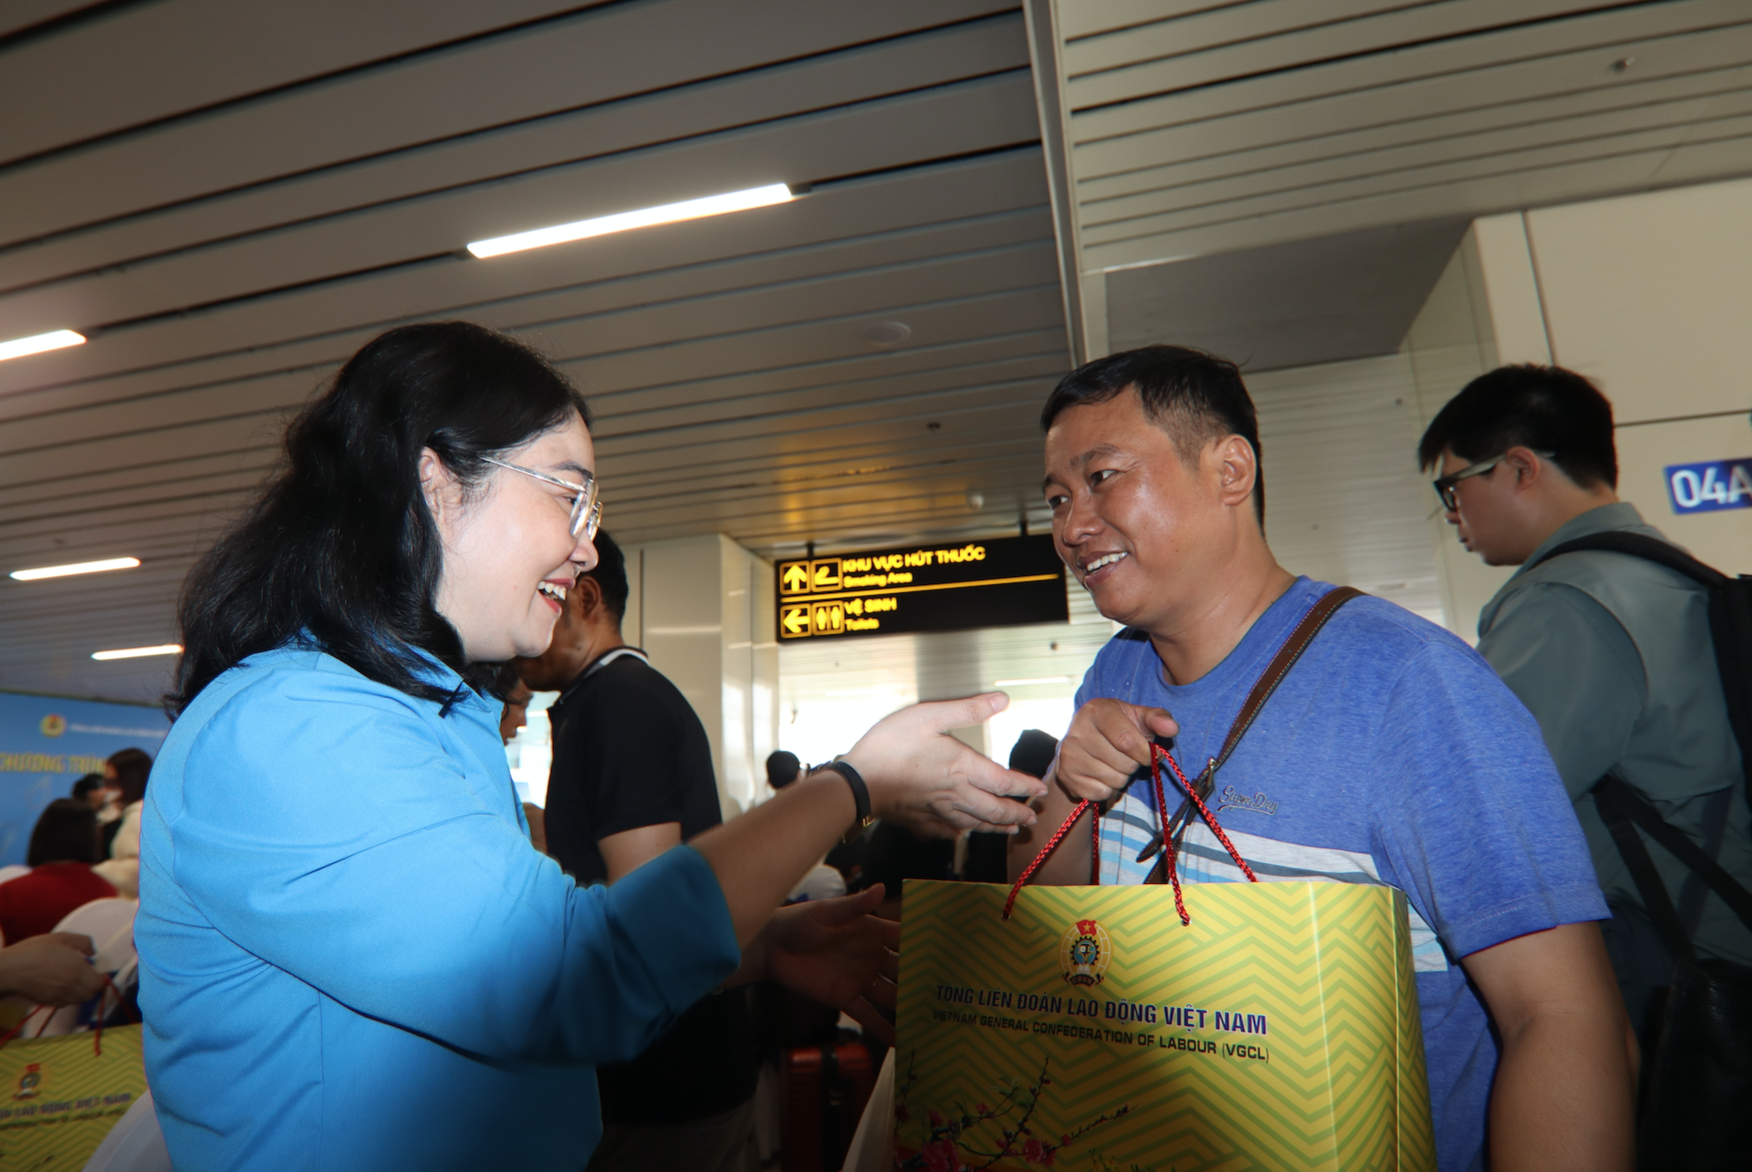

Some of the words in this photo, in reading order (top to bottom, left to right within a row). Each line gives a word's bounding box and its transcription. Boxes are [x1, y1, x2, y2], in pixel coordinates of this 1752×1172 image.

[1671, 464, 1752, 508] 04A
[843, 557, 872, 572] KHU
[873, 554, 903, 571] VỰC
[905, 550, 933, 567] HÚT
[935, 544, 985, 563] THUỐC
[887, 571, 913, 584] Area
[844, 598, 863, 616] VỆ
[864, 597, 897, 613] SINH
[978, 987, 1013, 1008] LIÊN
[1016, 991, 1062, 1013] ĐOÀN
[1066, 998, 1099, 1018] LAO
[1104, 998, 1157, 1025] ĐỘNG
[1163, 1003, 1208, 1032] VIỆT
[1214, 1010, 1267, 1035] NAM
[932, 1009, 977, 1025] VIETNAM
[980, 1015, 1029, 1031] GENERAL
[1032, 1022, 1133, 1044] CONFEDERATION
[1137, 1033, 1155, 1047] OF
[1159, 1036, 1217, 1054] LABOUR
[1221, 1042, 1270, 1064] (VGCL)
